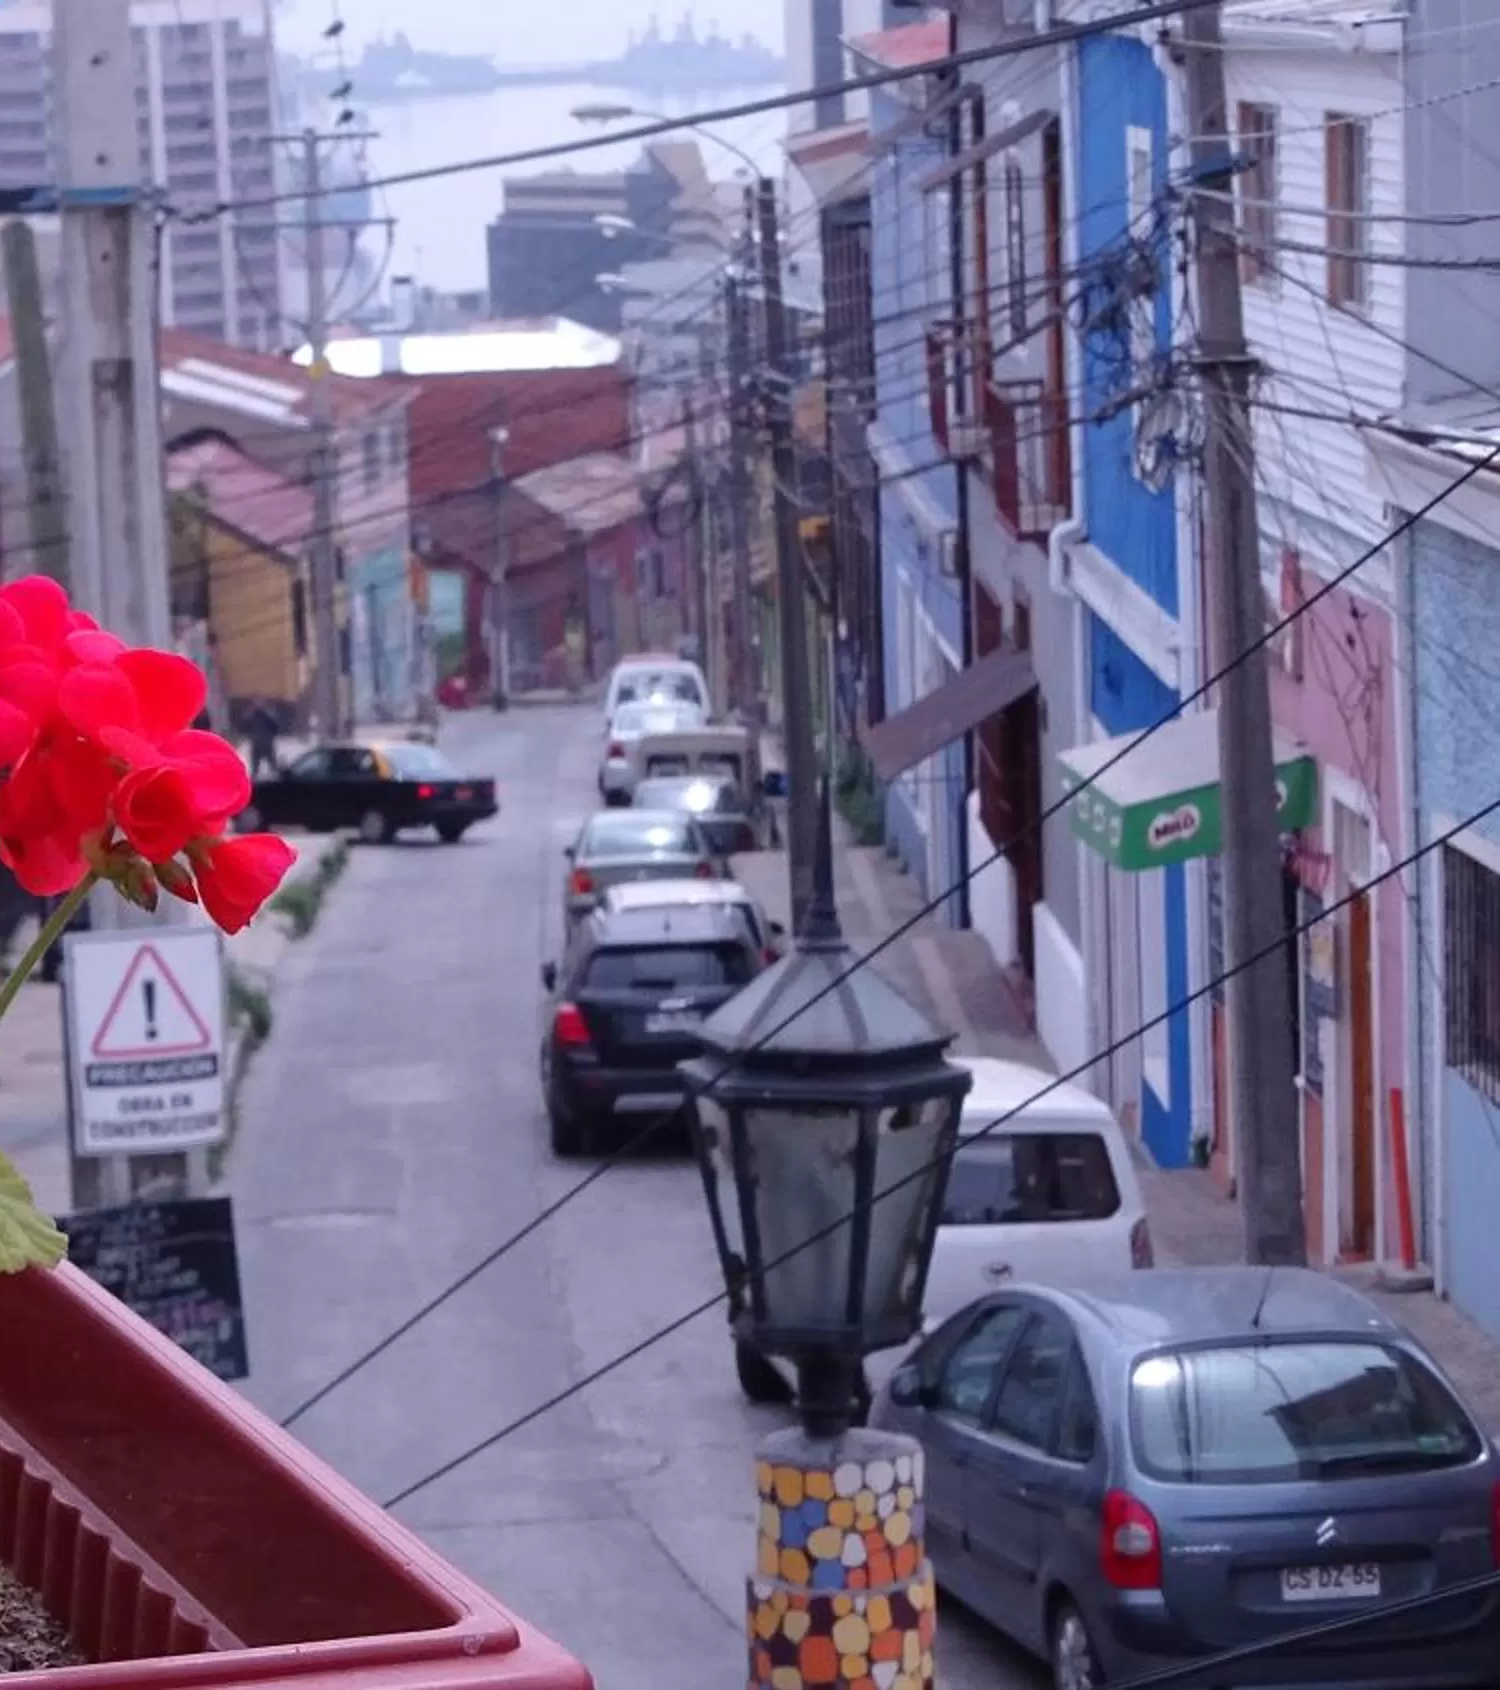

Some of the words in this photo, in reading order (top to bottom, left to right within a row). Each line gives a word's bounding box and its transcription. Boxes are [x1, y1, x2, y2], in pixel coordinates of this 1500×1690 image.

[1155, 812, 1195, 841] MILO
[118, 1096, 164, 1113] OBRA
[171, 1094, 192, 1109] EN
